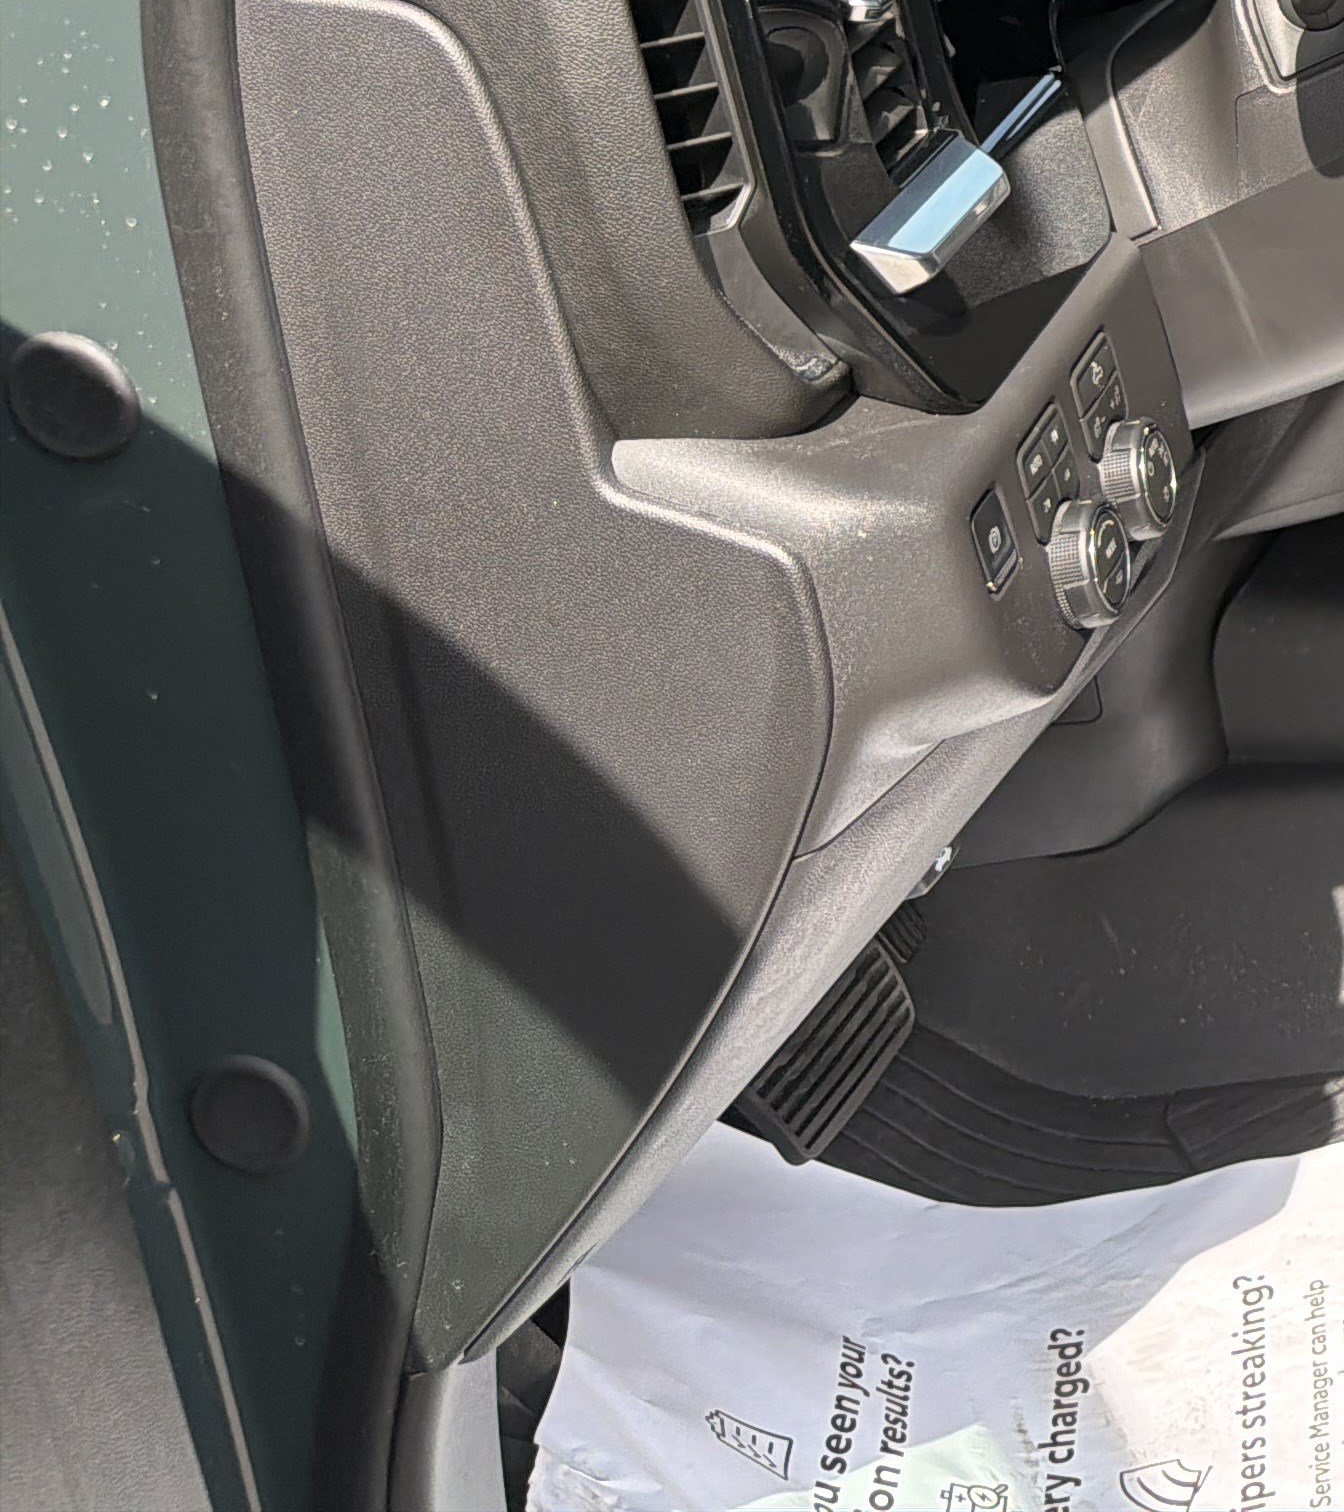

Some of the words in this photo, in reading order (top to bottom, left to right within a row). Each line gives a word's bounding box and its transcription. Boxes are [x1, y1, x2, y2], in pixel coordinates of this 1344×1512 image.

[1303, 1279, 1330, 1322] help
[837, 1335, 871, 1398] your
[1231, 1275, 1274, 1430] streaking?
[1311, 1323, 1327, 1356] can
[875, 1352, 915, 1457] results?
[1037, 1328, 1090, 1464] charged?
[1308, 1360, 1334, 1440] Manager
[820, 1394, 861, 1475] seen
[814, 1480, 841, 1512] ou
[867, 1464, 901, 1512] on
[1230, 1436, 1276, 1512] ipers
[1308, 1441, 1332, 1509] Service
